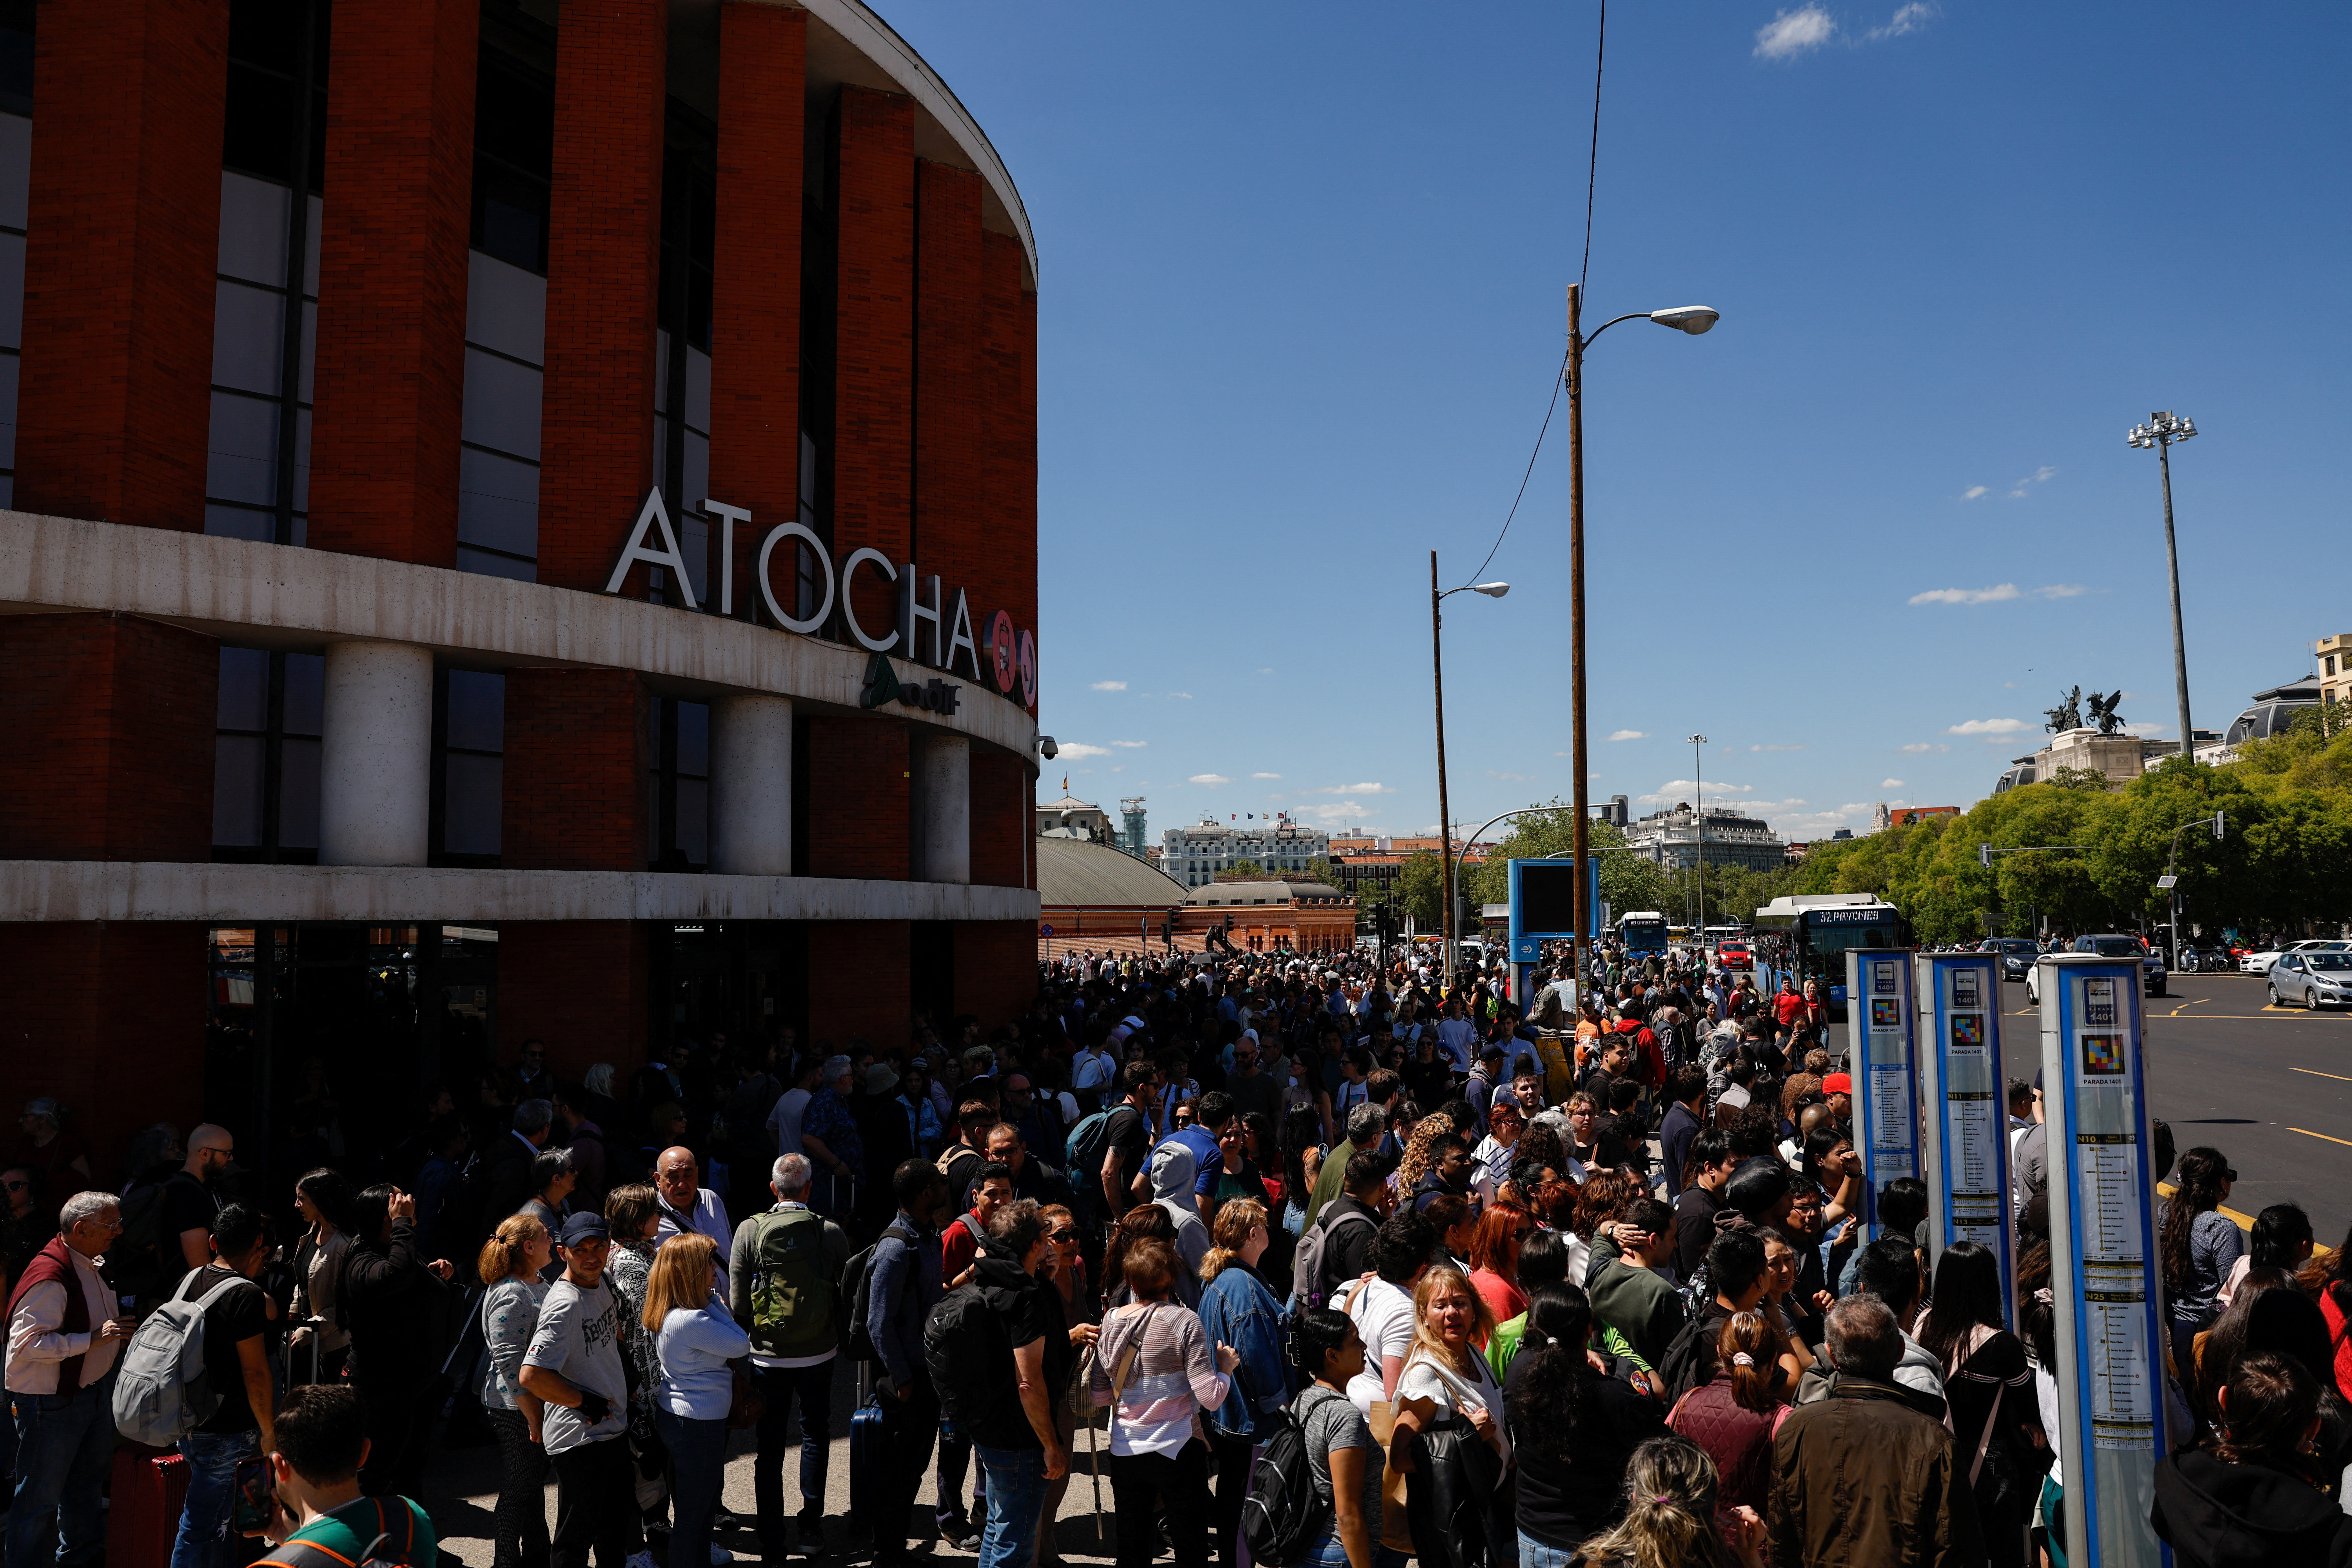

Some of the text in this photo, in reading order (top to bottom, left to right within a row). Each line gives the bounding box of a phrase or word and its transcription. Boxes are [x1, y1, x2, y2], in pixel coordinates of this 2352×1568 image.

[604, 485, 981, 681] ATOCHA
[906, 679, 962, 715] adif
[1820, 911, 1831, 922] 32
[2090, 1012, 2114, 1021] 1401
